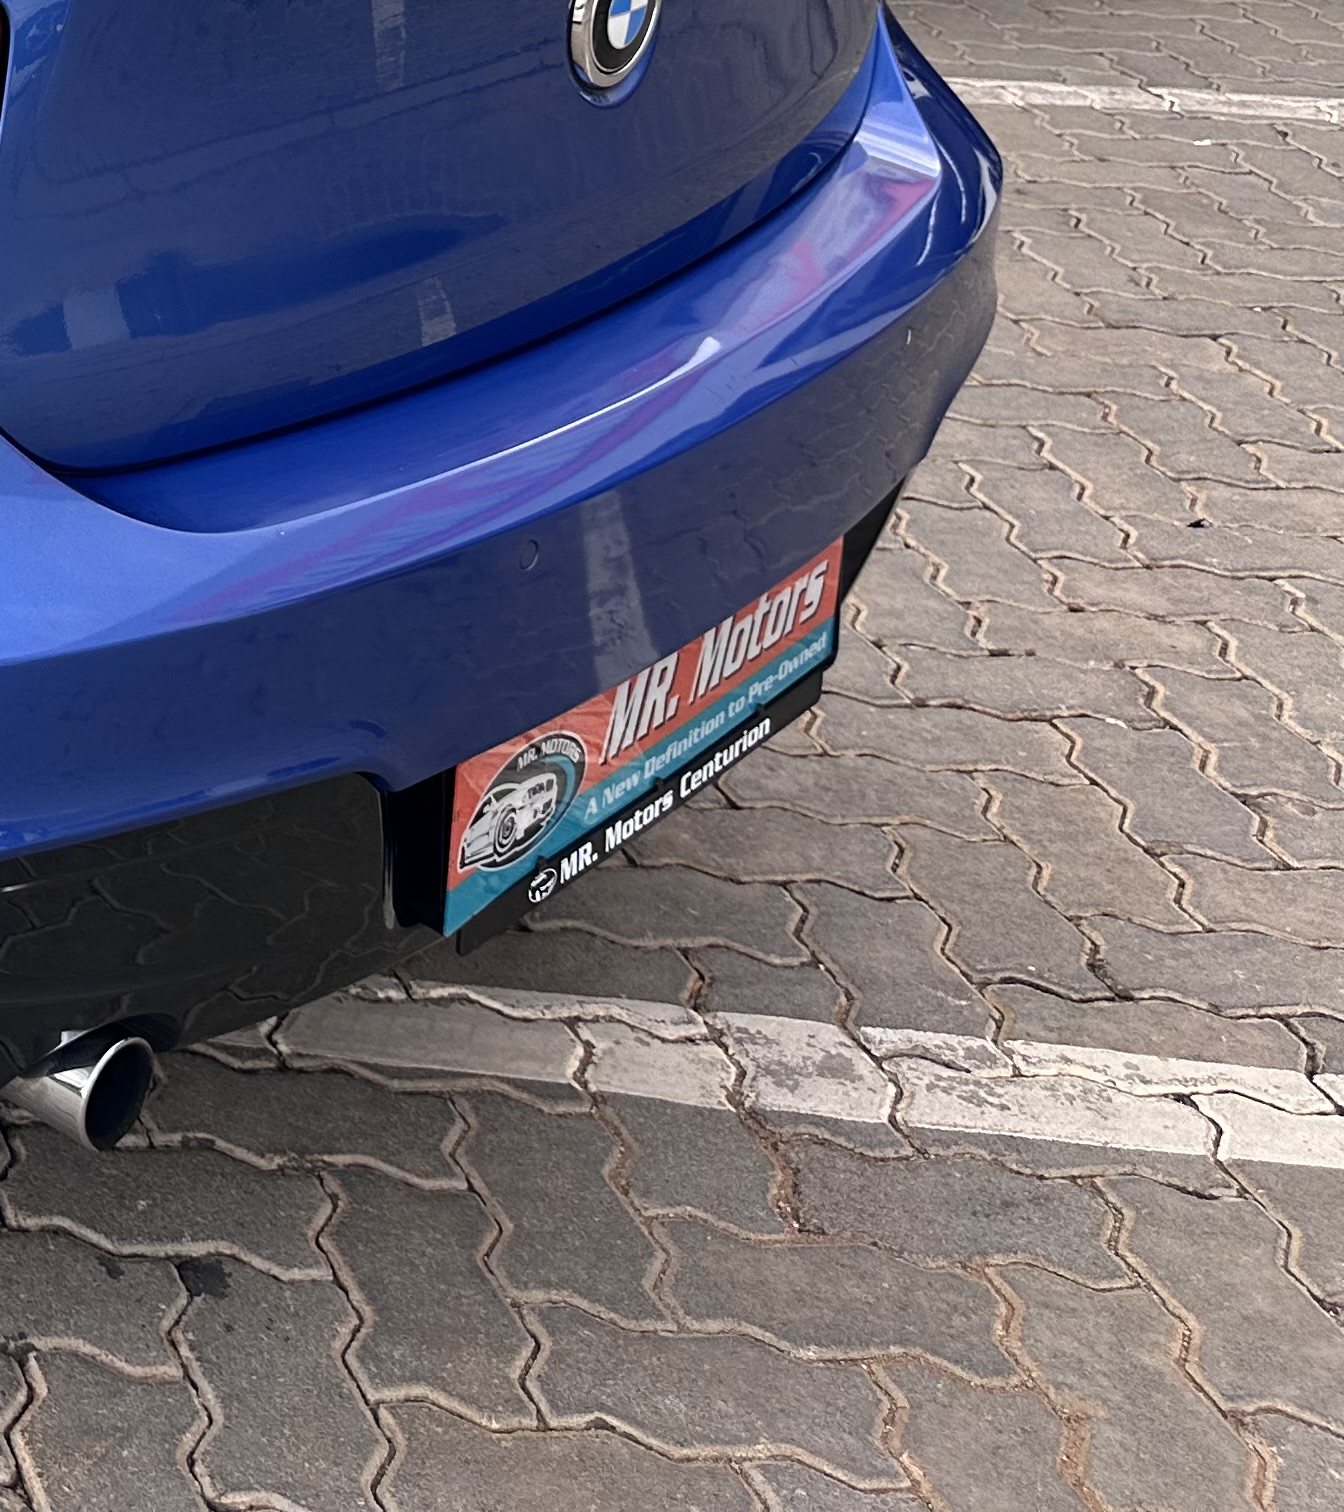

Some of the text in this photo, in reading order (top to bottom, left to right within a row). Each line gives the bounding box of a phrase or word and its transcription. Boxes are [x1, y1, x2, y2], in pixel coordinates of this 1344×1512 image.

[583, 631, 828, 821] A New Definition to Pre-Owned
[599, 559, 829, 766] MR. Motors
[516, 738, 582, 773] MR. MOTORS
[559, 717, 771, 884] MR. Motors Centurion
